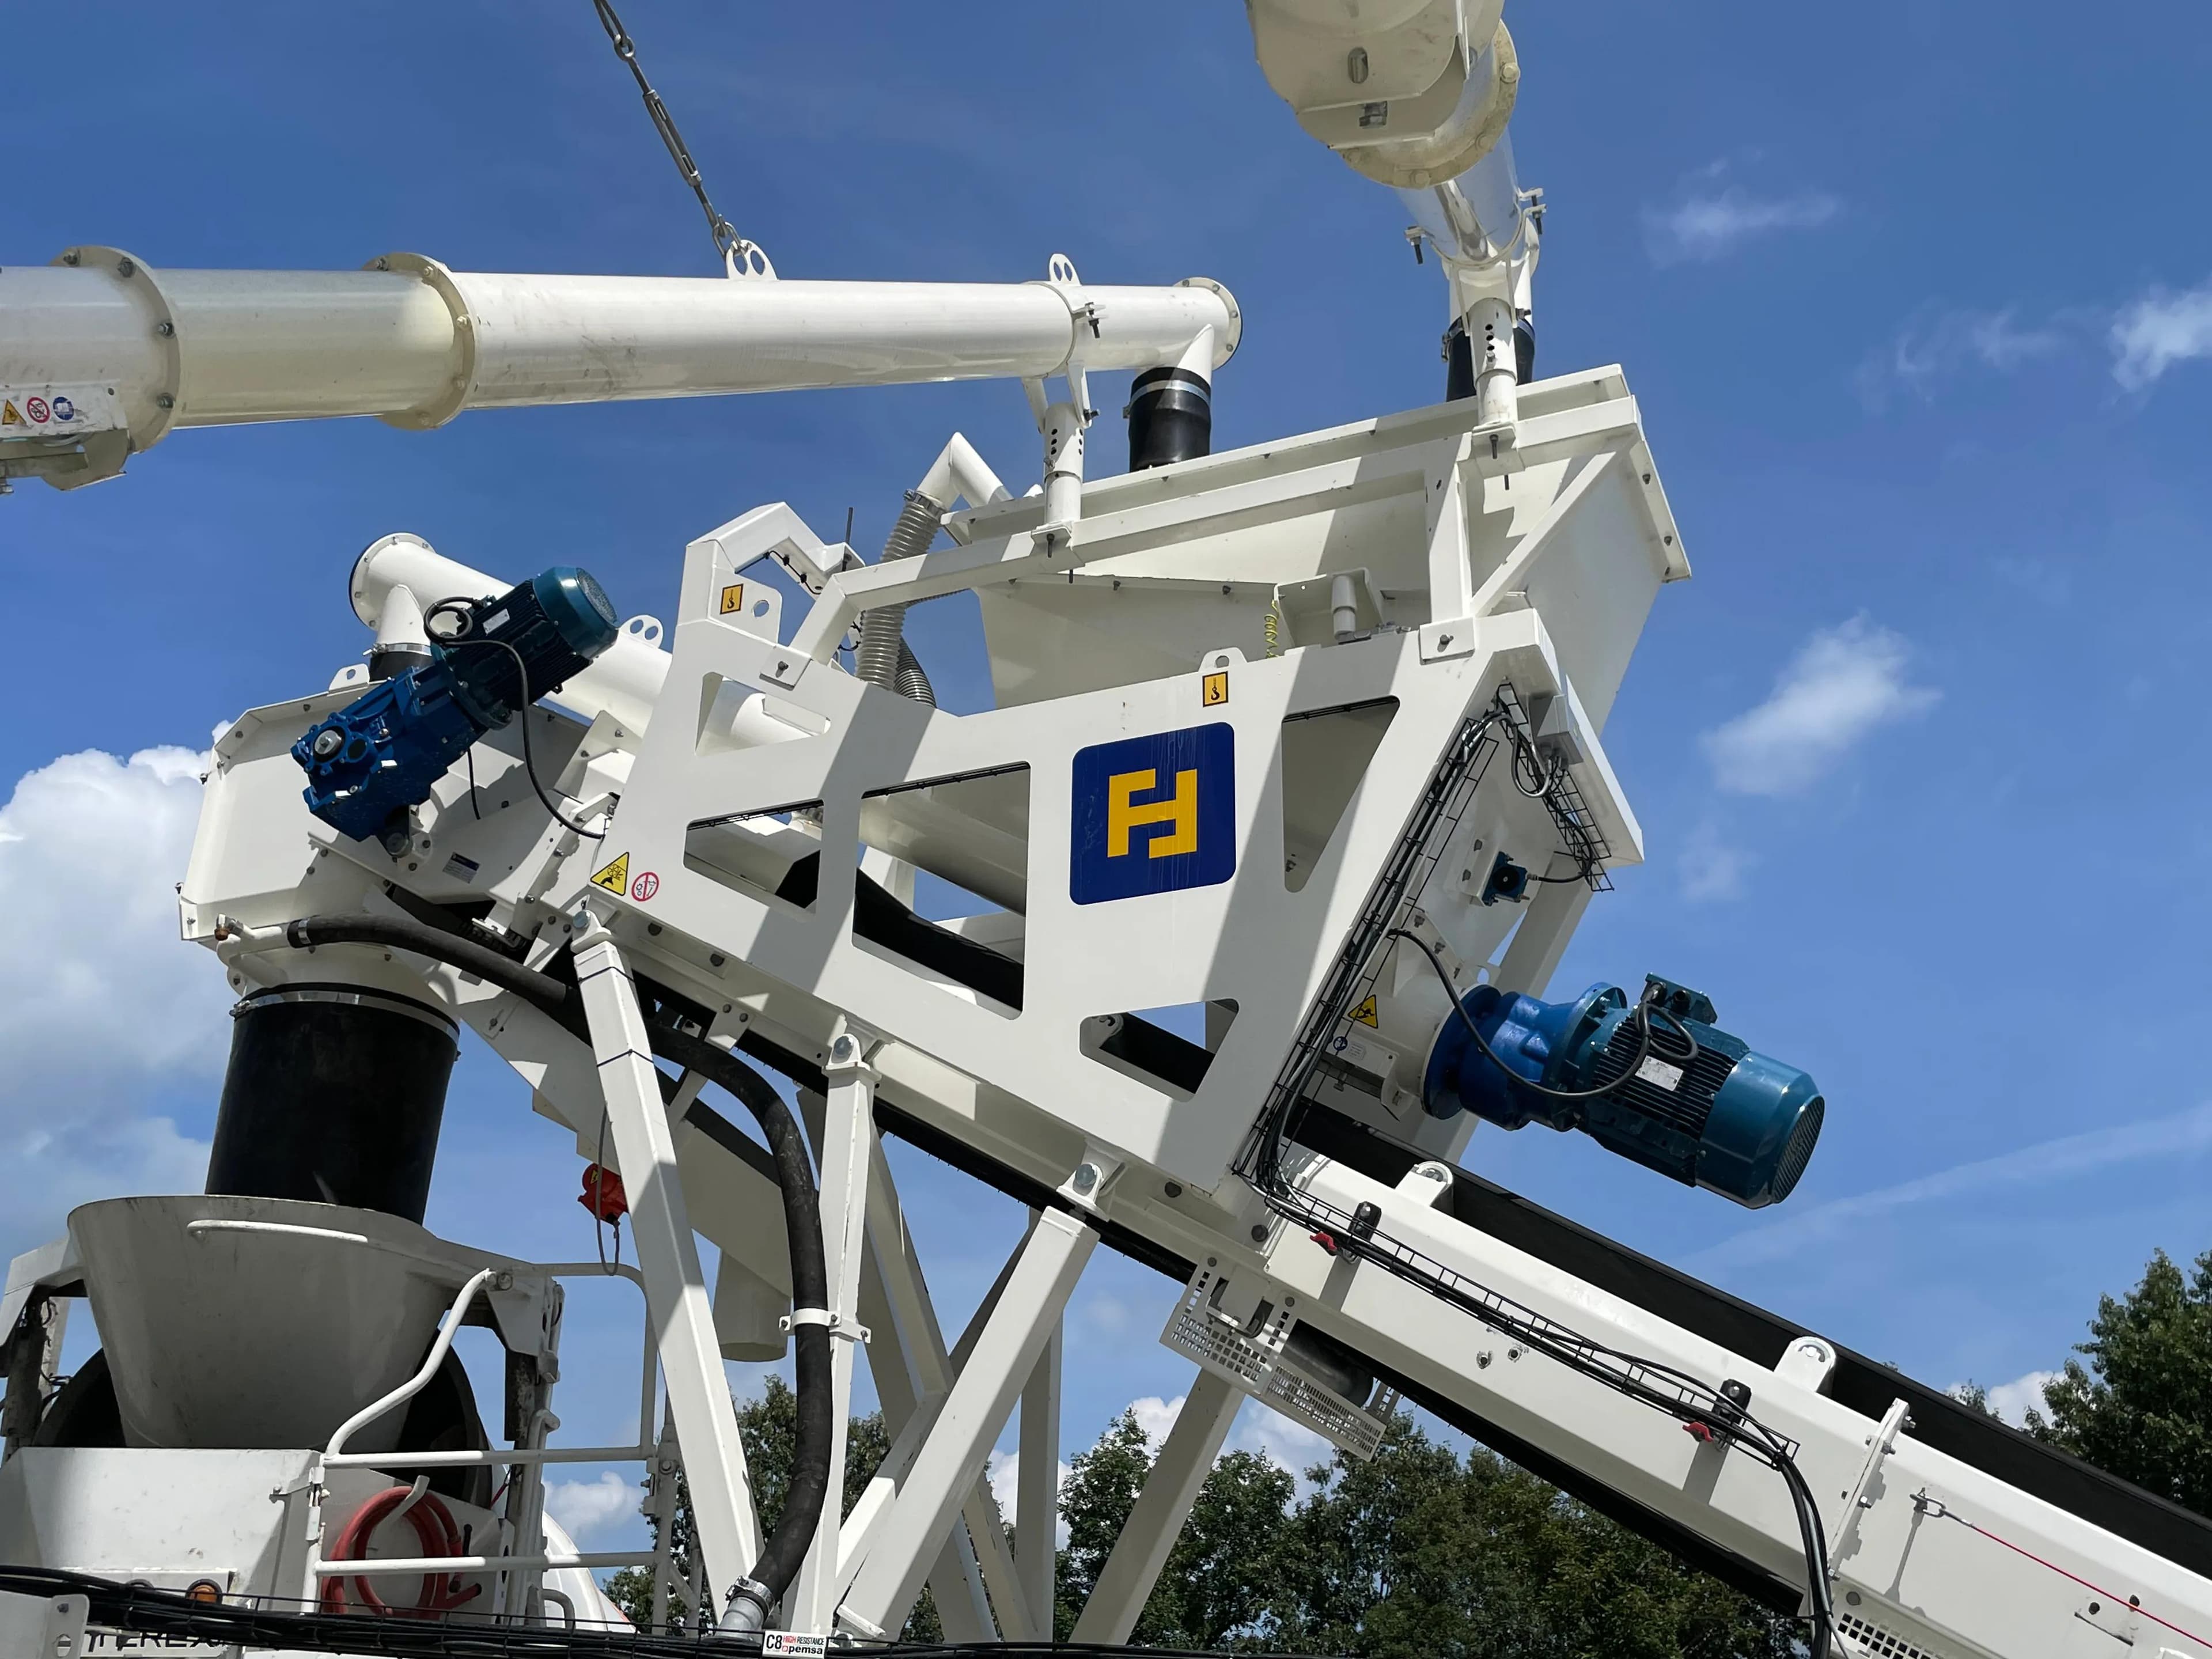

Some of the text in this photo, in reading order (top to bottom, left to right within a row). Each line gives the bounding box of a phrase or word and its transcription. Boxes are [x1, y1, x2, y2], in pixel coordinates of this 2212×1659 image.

[766, 1634, 783, 1649] C8
[797, 1637, 824, 1645] RESISTANCE
[789, 1646, 823, 1654] pemsa
